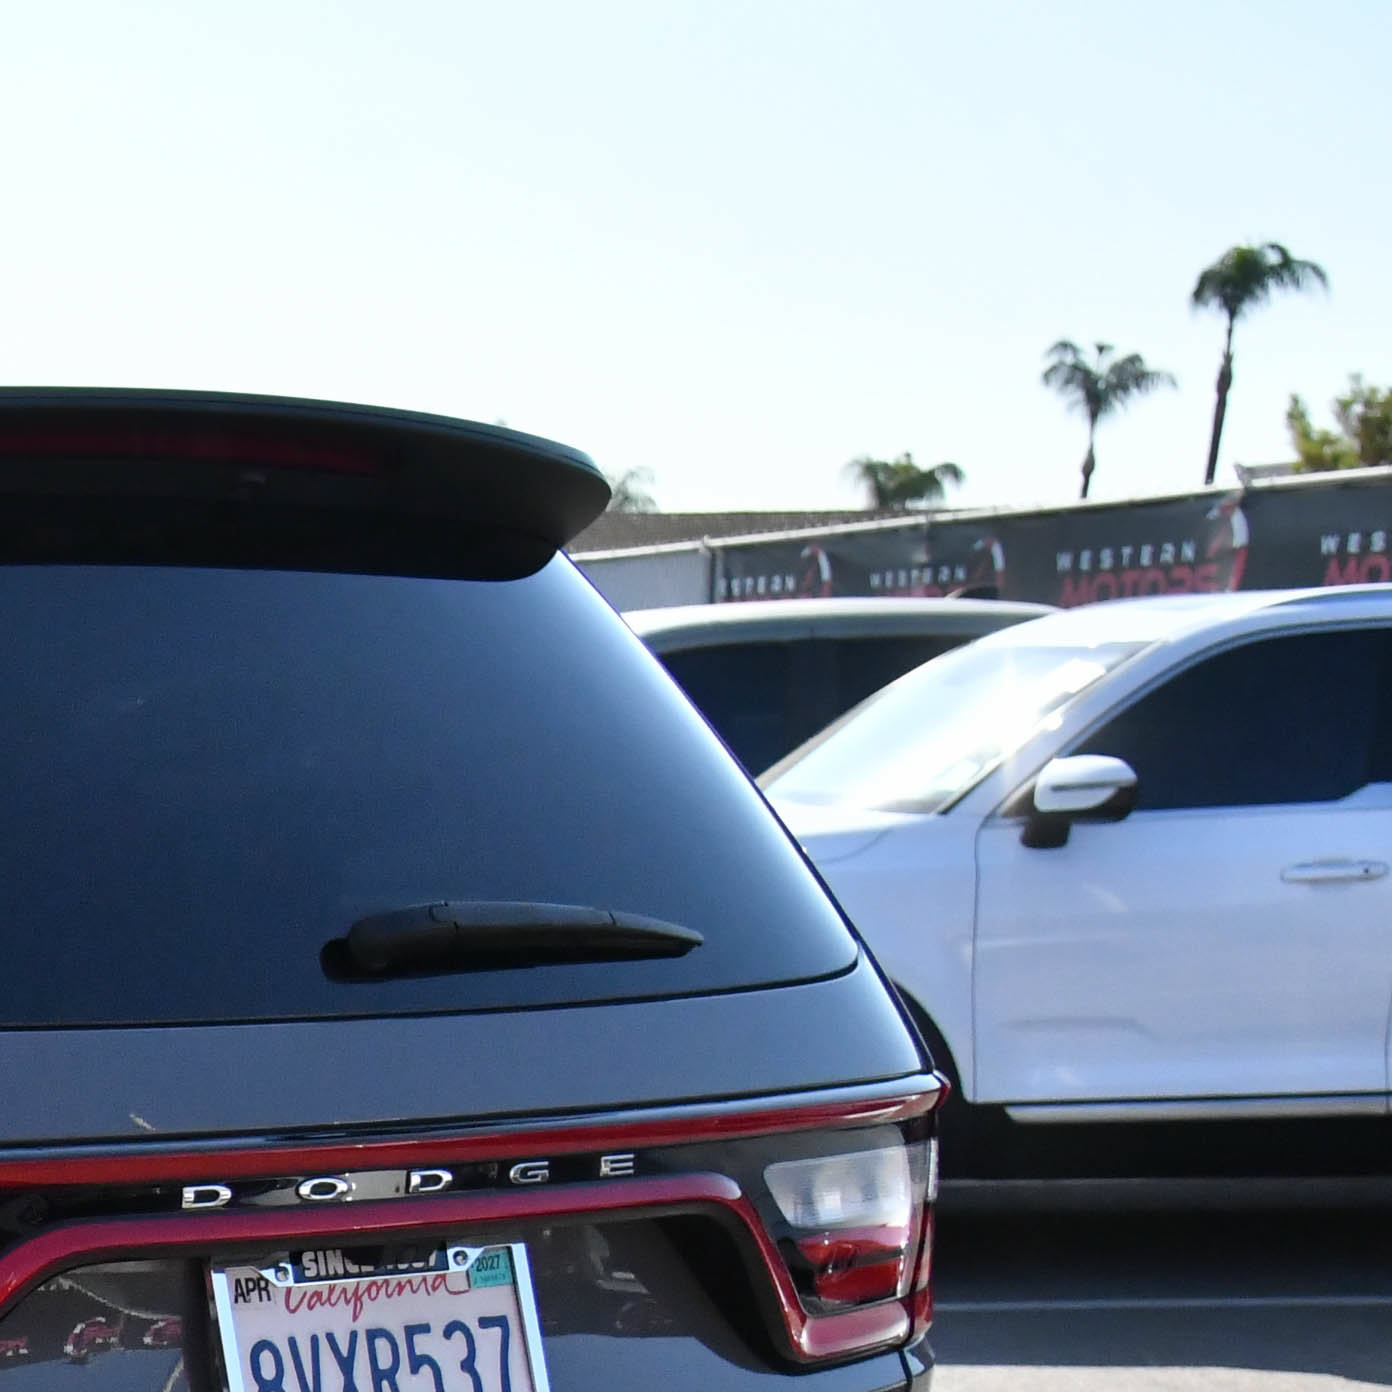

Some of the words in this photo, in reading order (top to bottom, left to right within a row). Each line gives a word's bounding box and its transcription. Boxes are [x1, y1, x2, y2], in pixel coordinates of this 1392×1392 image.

[1056, 541, 1196, 572] WESTERN
[869, 565, 967, 589] WESTERN
[181, 1153, 637, 1210] DODGE
[476, 1254, 501, 1272] 2027
[234, 1277, 271, 1304] APR
[284, 1272, 470, 1322] California
